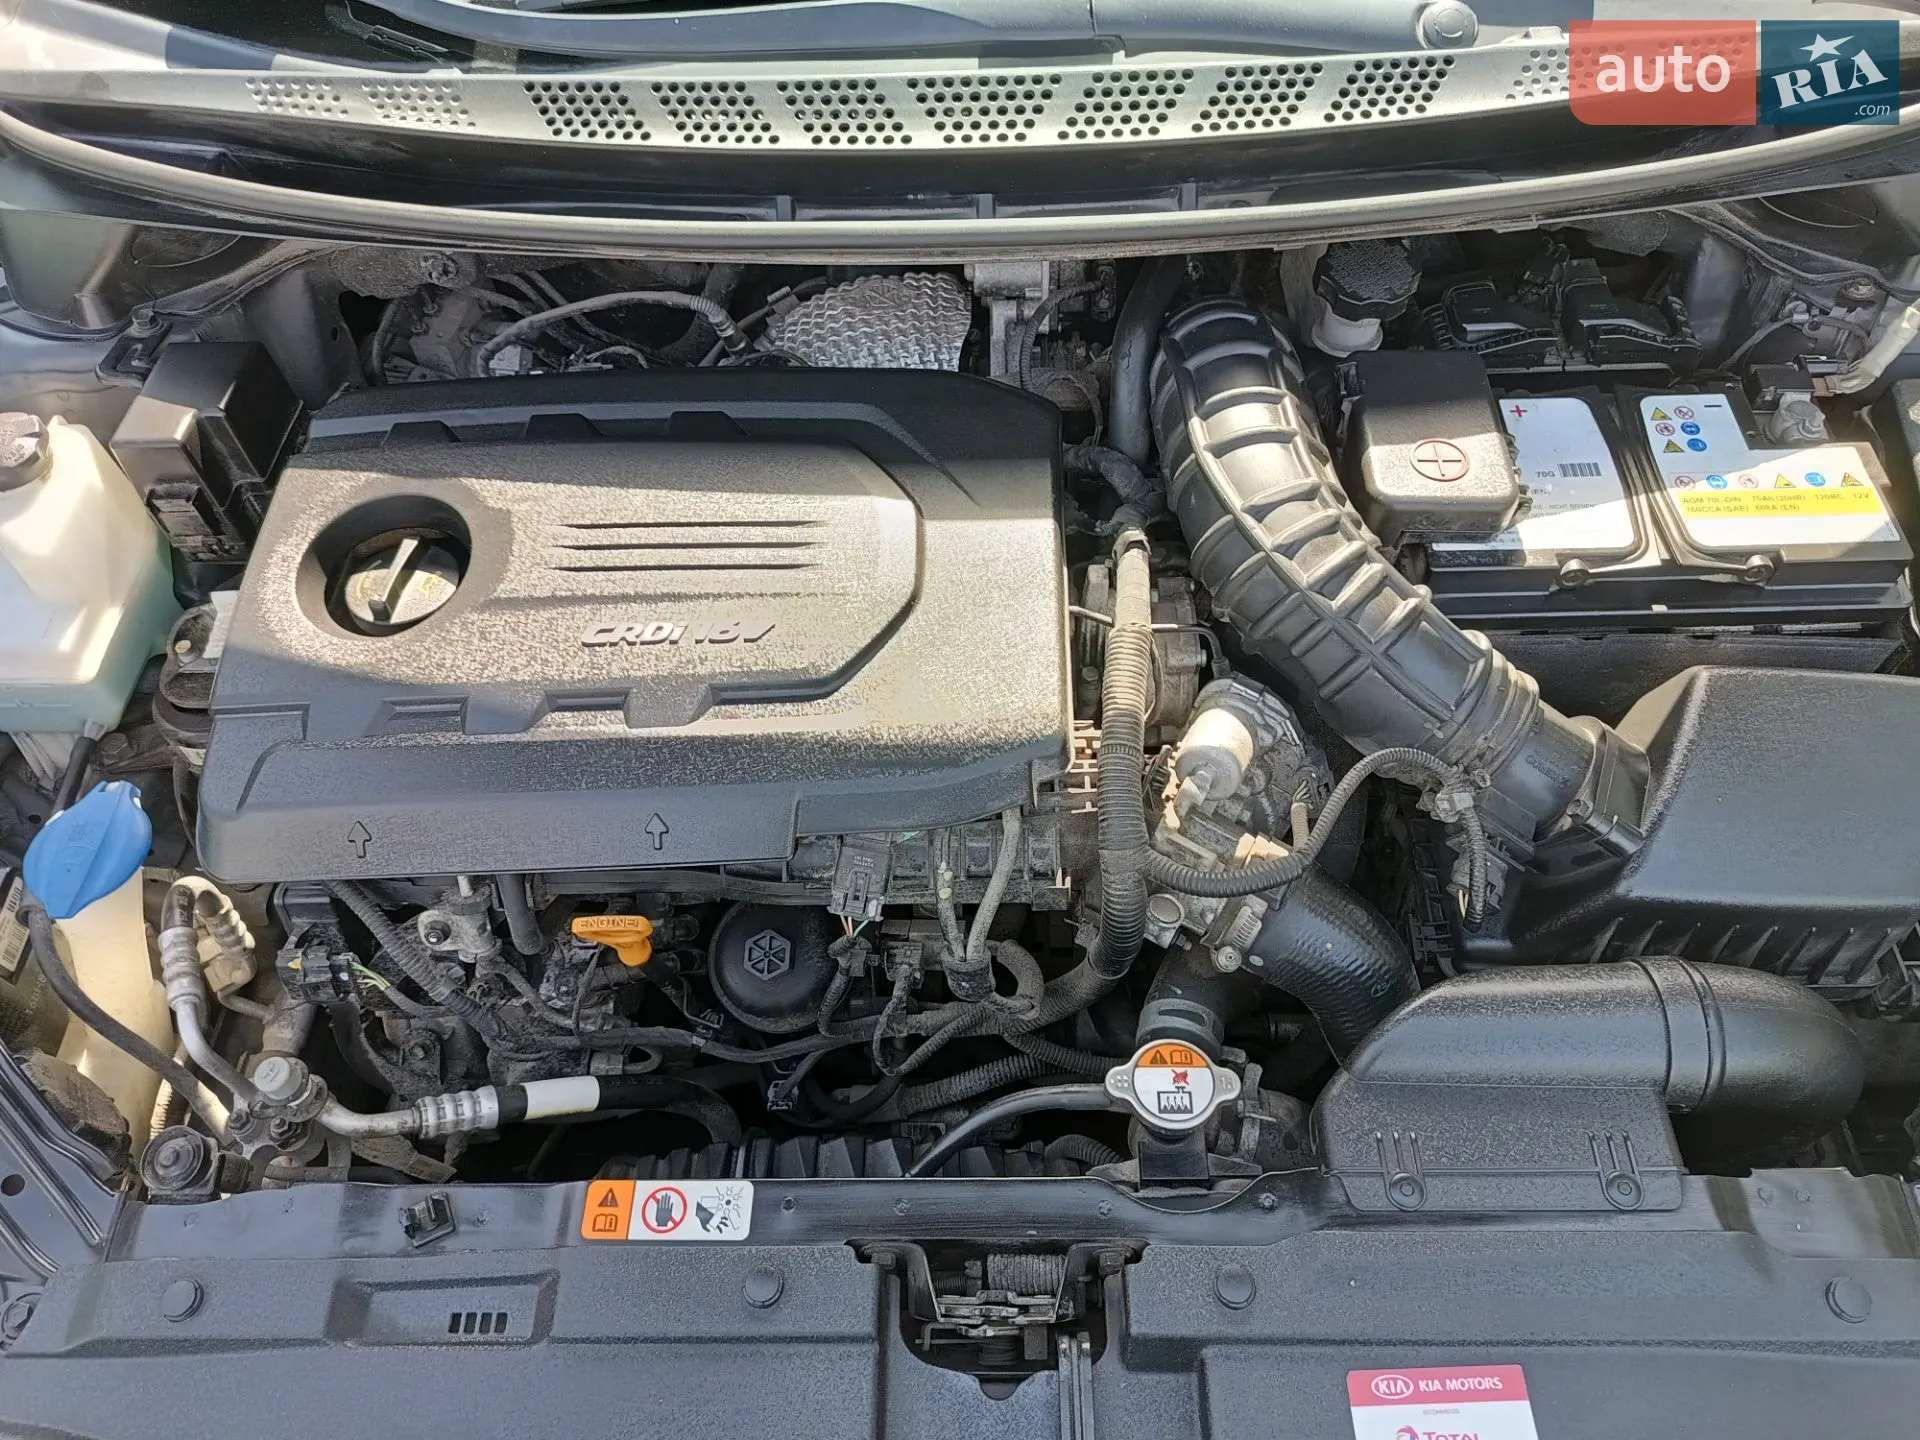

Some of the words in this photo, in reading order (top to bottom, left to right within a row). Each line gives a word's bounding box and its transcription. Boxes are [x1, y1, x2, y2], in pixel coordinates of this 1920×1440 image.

[579, 916, 638, 929] ENGINE
[1378, 1380, 1408, 1394] KIA
[1418, 1379, 1443, 1393] KIA
[1445, 1376, 1504, 1392] MOTORS
